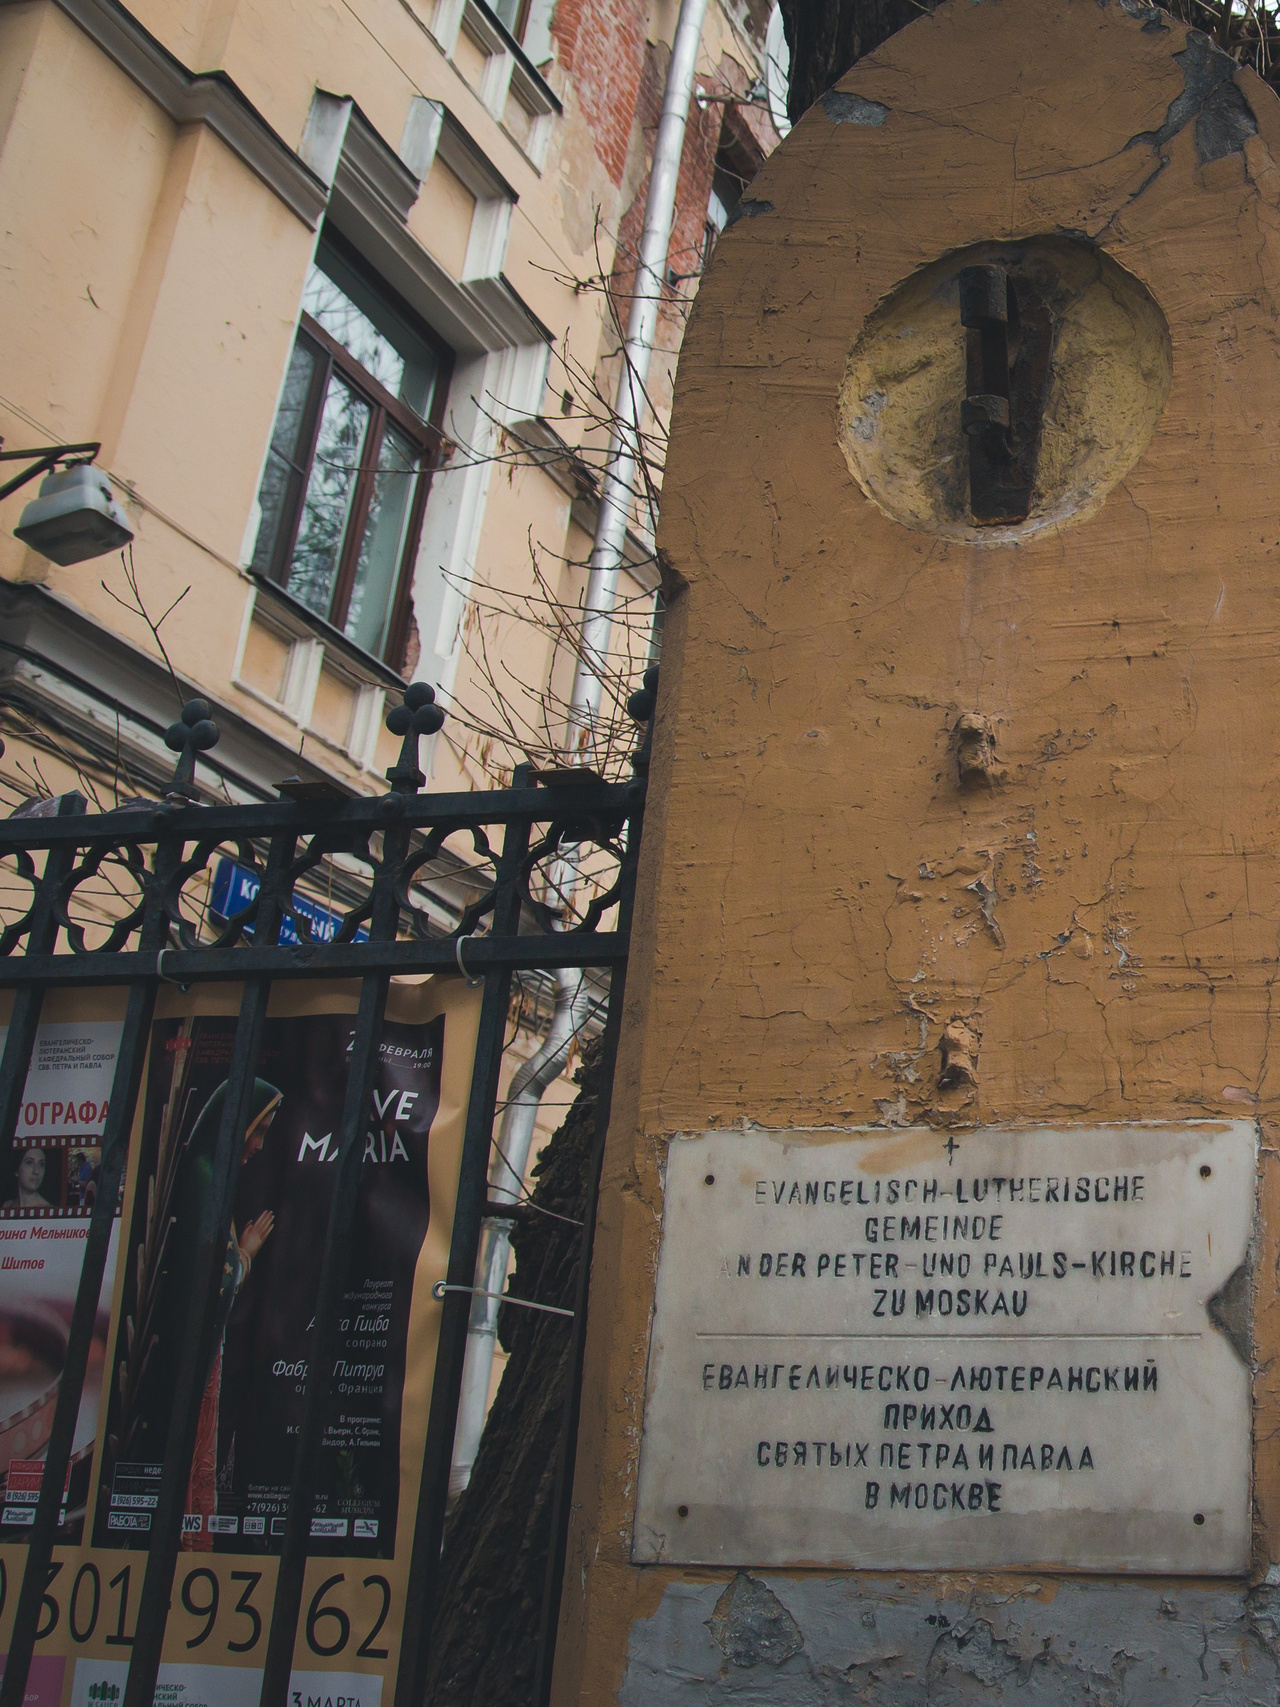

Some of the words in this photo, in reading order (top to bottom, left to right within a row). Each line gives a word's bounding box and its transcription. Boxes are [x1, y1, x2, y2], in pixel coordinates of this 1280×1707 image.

[39, 1038, 95, 1047] ЕВАНГЕЛИЧЕСКО-
[39, 1046, 86, 1055] ЛЮТЕРАНСКИЙ
[38, 1054, 91, 1063] КАФЕДРАЛЬНЫЙ
[92, 1053, 115, 1061] СОБОР
[412, 1061, 432, 1069] 19:00
[370, 1088, 419, 1121] VE
[20, 1101, 110, 1126] ОГРАФА
[755, 1176, 1145, 1205] EVANGELISCH-LUTHERISCHE
[0, 1228, 28, 1241] рина
[30, 1226, 90, 1240] Мельников
[865, 1215, 1004, 1243] GEMEINDE
[1, 1257, 46, 1270] Шитов
[758, 1252, 808, 1278] DER
[984, 1250, 1193, 1279] PAULS-KIRCHE
[363, 1279, 394, 1291] Лауреат
[343, 1290, 393, 1302] ждународного
[873, 1289, 907, 1318] ZU
[915, 1289, 1028, 1318] MOSKAU
[353, 1314, 390, 1334] Гицба
[345, 1339, 388, 1350] сопрано
[332, 1360, 385, 1382] Питруа
[338, 1383, 384, 1396] Франция
[884, 1403, 995, 1432] ПРИХОД
[757, 1441, 870, 1467] СВЯТЫХ
[880, 1443, 969, 1470] ПЕТРА
[979, 1444, 994, 1471] И
[1002, 1444, 1095, 1471] ПАВЛА
[143, 1466, 162, 1475] неде
[111, 1495, 116, 1504] 8
[865, 1482, 880, 1510] В
[891, 1480, 1002, 1512] МОСКВЕ
[110, 1515, 138, 1527] РАБОТА
